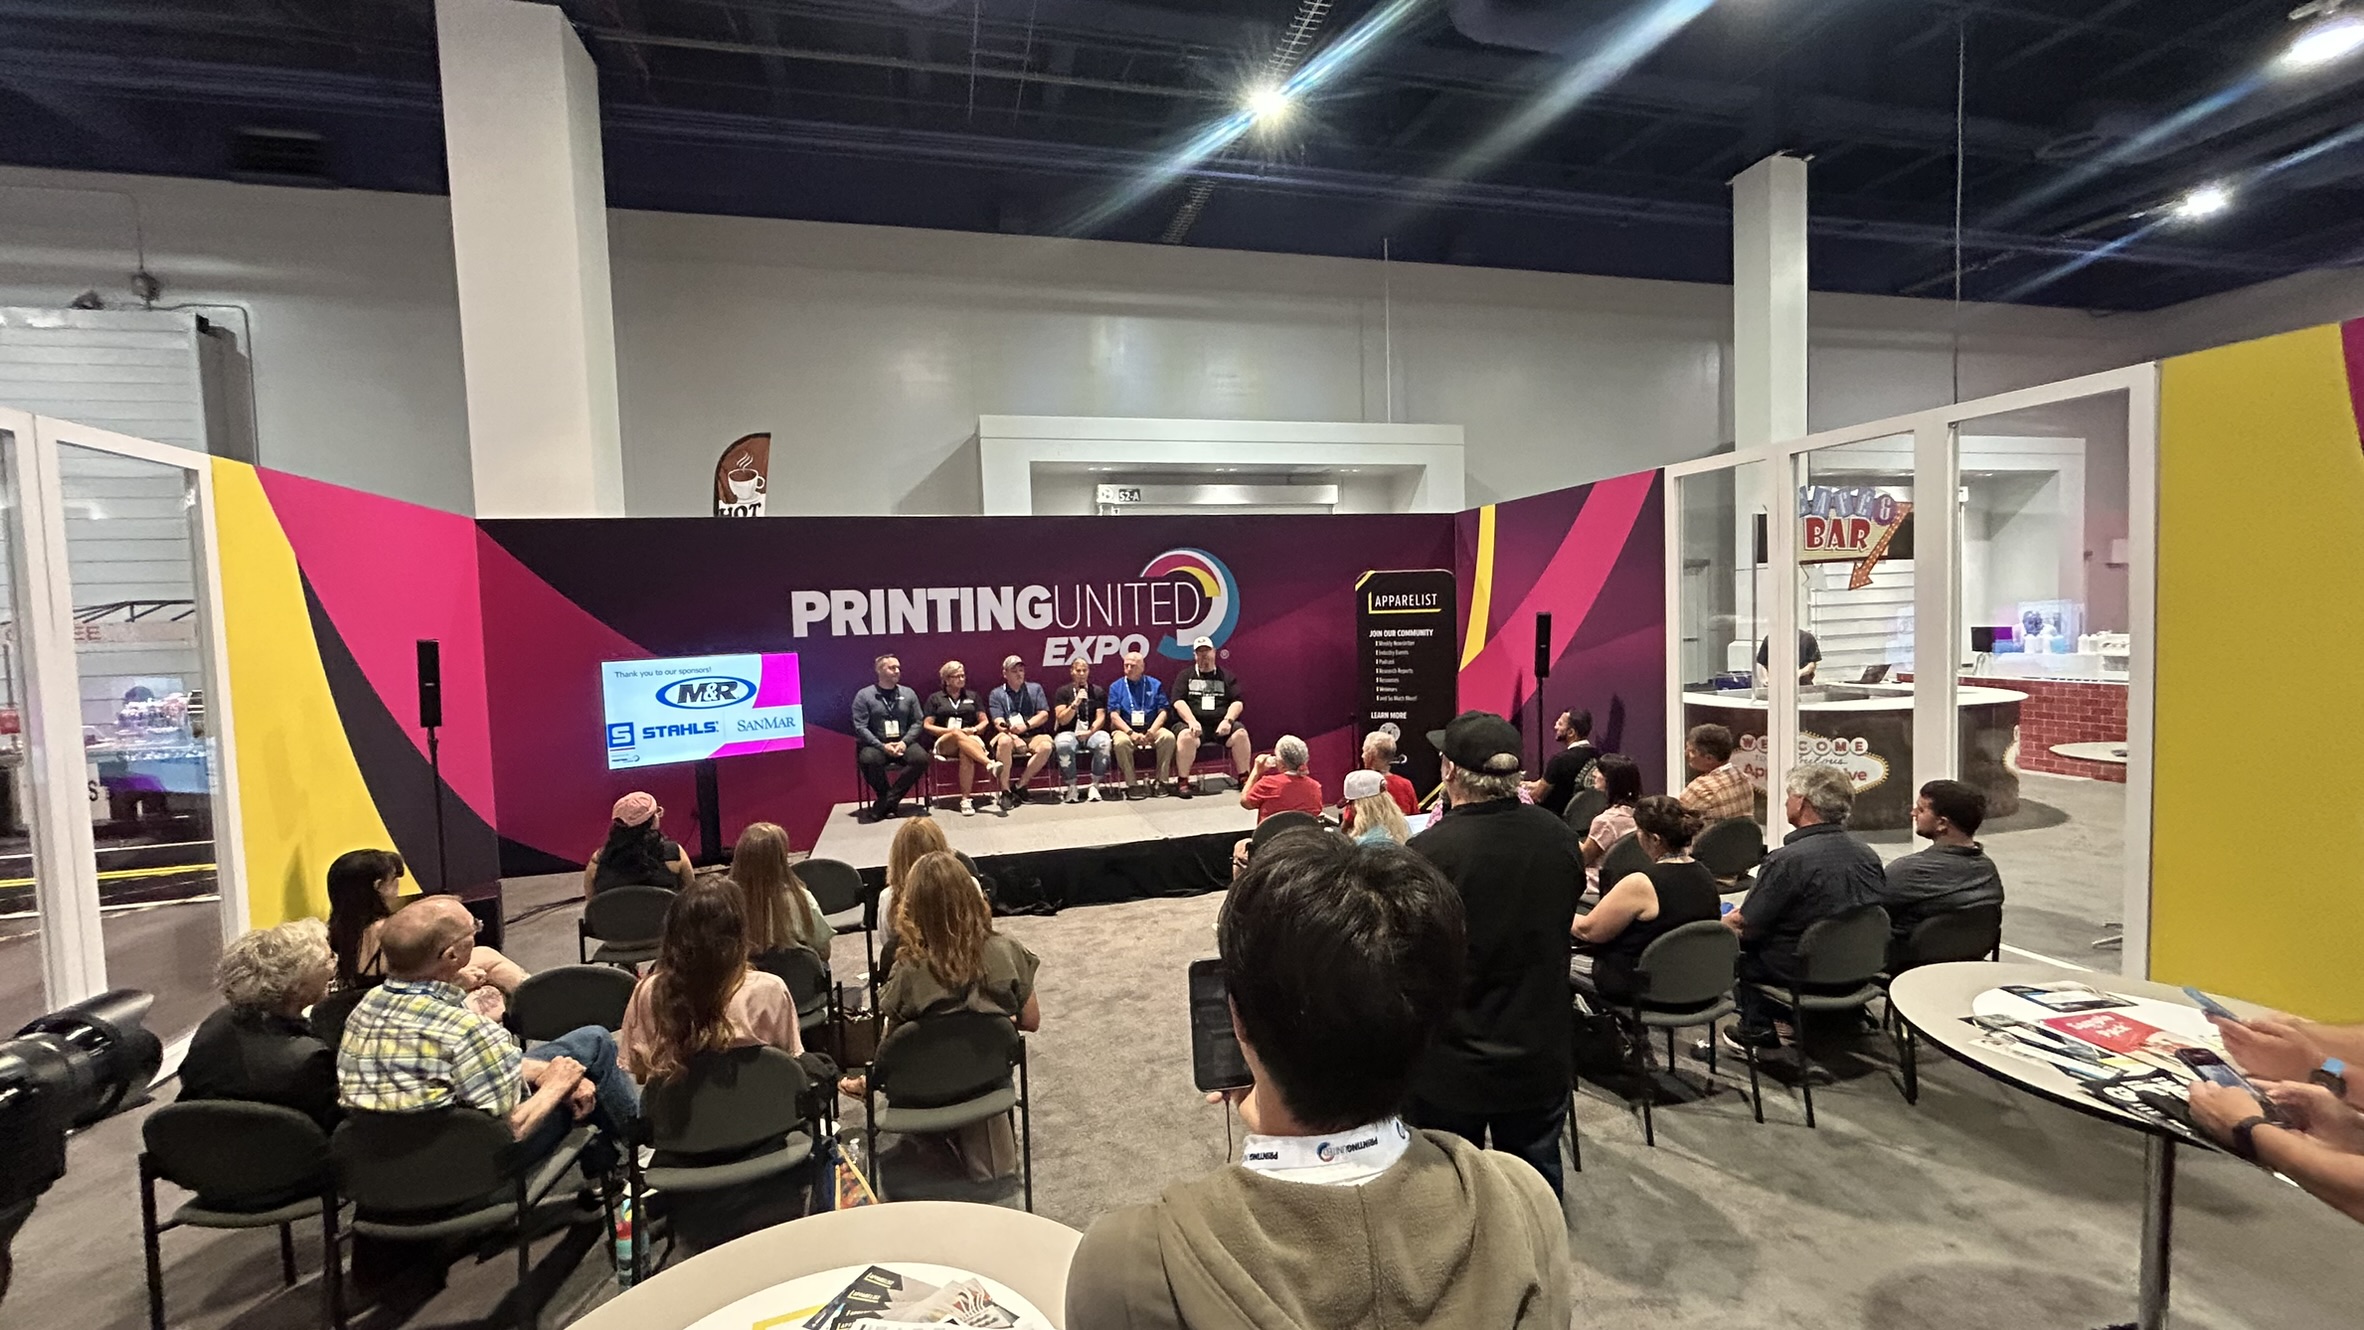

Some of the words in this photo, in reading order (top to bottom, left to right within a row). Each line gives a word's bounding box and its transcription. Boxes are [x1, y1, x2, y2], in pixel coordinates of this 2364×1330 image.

[1804, 516, 1871, 552] BAR
[1374, 593, 1438, 607] APPARELIST
[1369, 629, 1383, 638] JOIN
[1383, 629, 1396, 637] OUR
[1397, 628, 1434, 637] COMMUNITY
[1042, 633, 1150, 667] EXPO
[614, 670, 638, 678] Thank
[640, 670, 653, 678] you
[679, 666, 712, 675] sponsors!
[677, 681, 738, 704] M&R
[1370, 711, 1390, 719] LEARN
[1390, 711, 1407, 719] MORE
